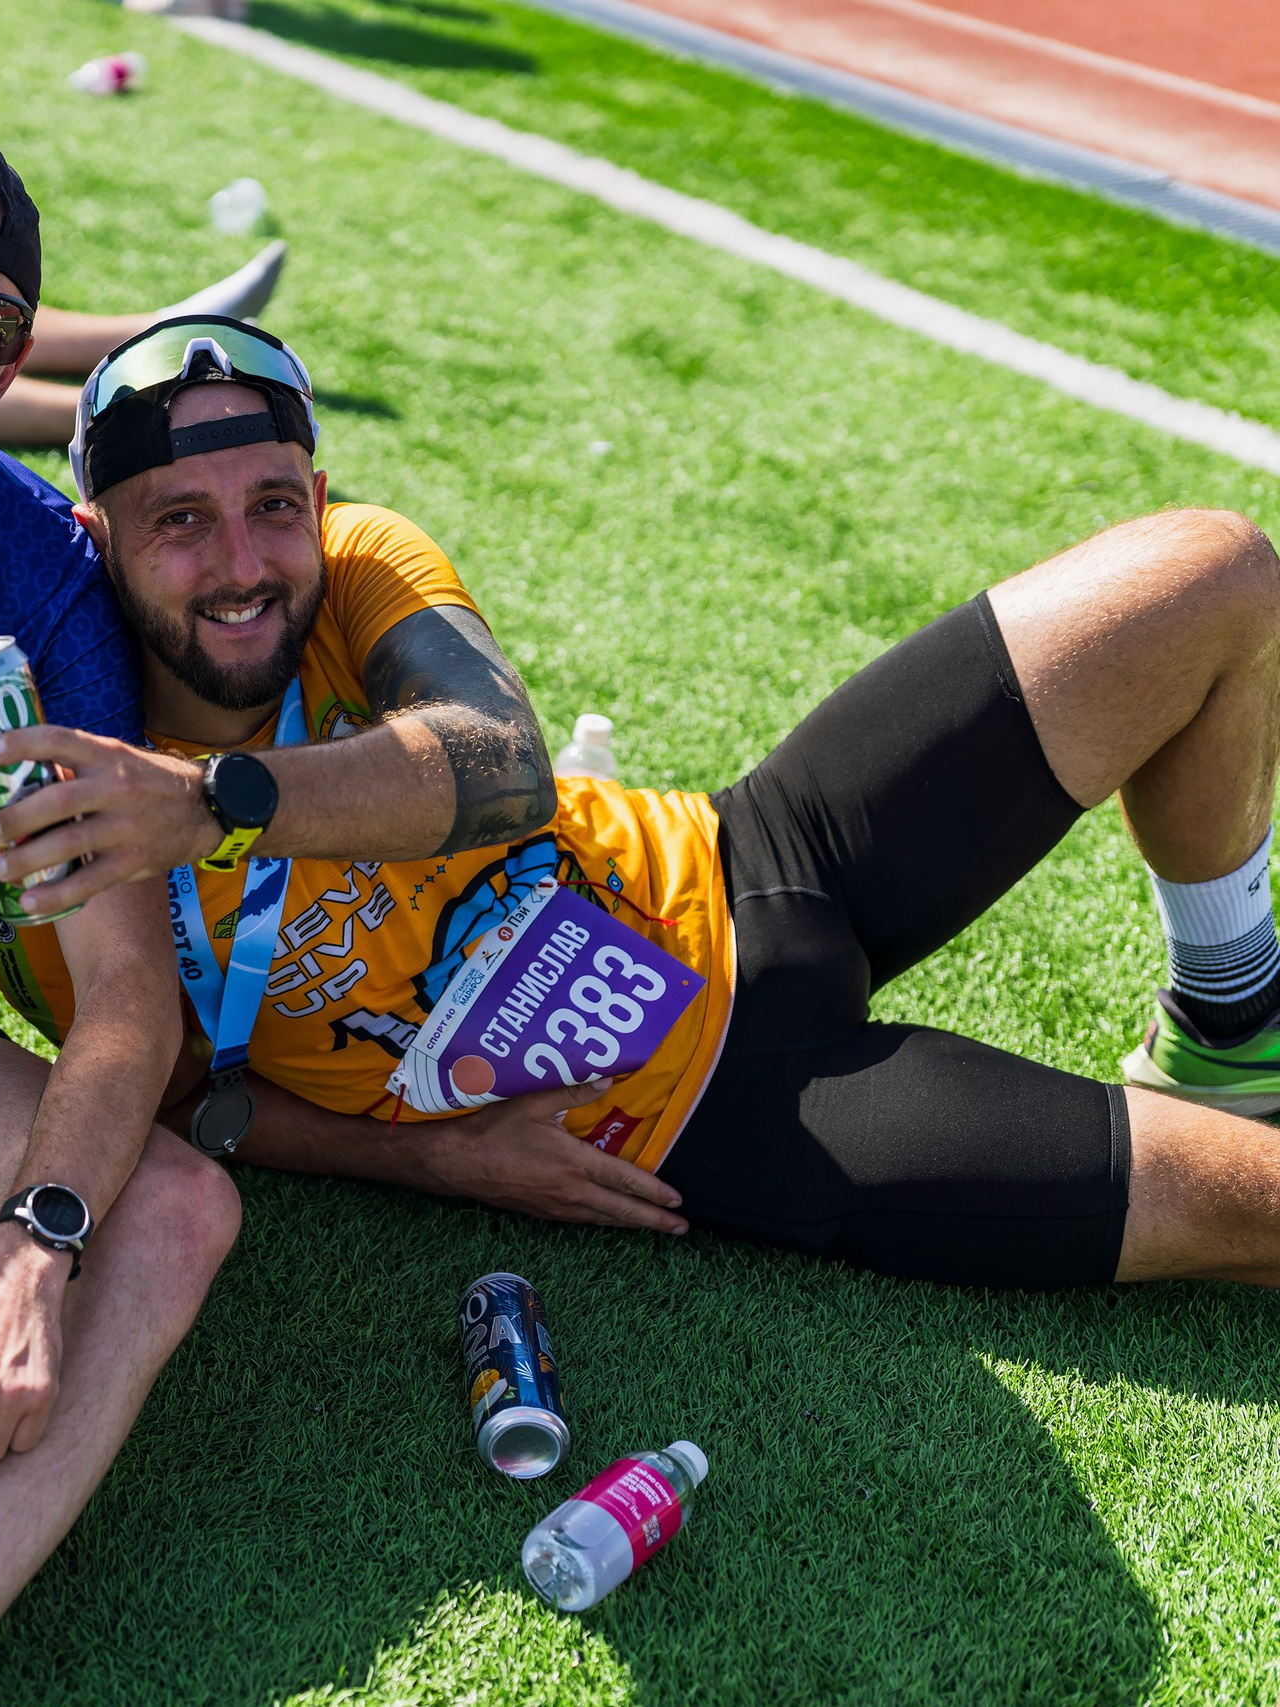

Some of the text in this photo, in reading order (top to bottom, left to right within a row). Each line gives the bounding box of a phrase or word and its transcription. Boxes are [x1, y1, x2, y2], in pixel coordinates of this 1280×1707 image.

[263, 881, 398, 997] GIVE
[507, 904, 531, 928] Пэй
[180, 957, 203, 981] 40
[272, 958, 368, 1018] UP
[460, 972, 485, 1006] МАРАФОН
[479, 919, 591, 1058] СТАНИСЛАВ
[426, 1020, 449, 1050] СПОРТ
[445, 1007, 456, 1020] 40
[523, 944, 667, 1086] 2383
